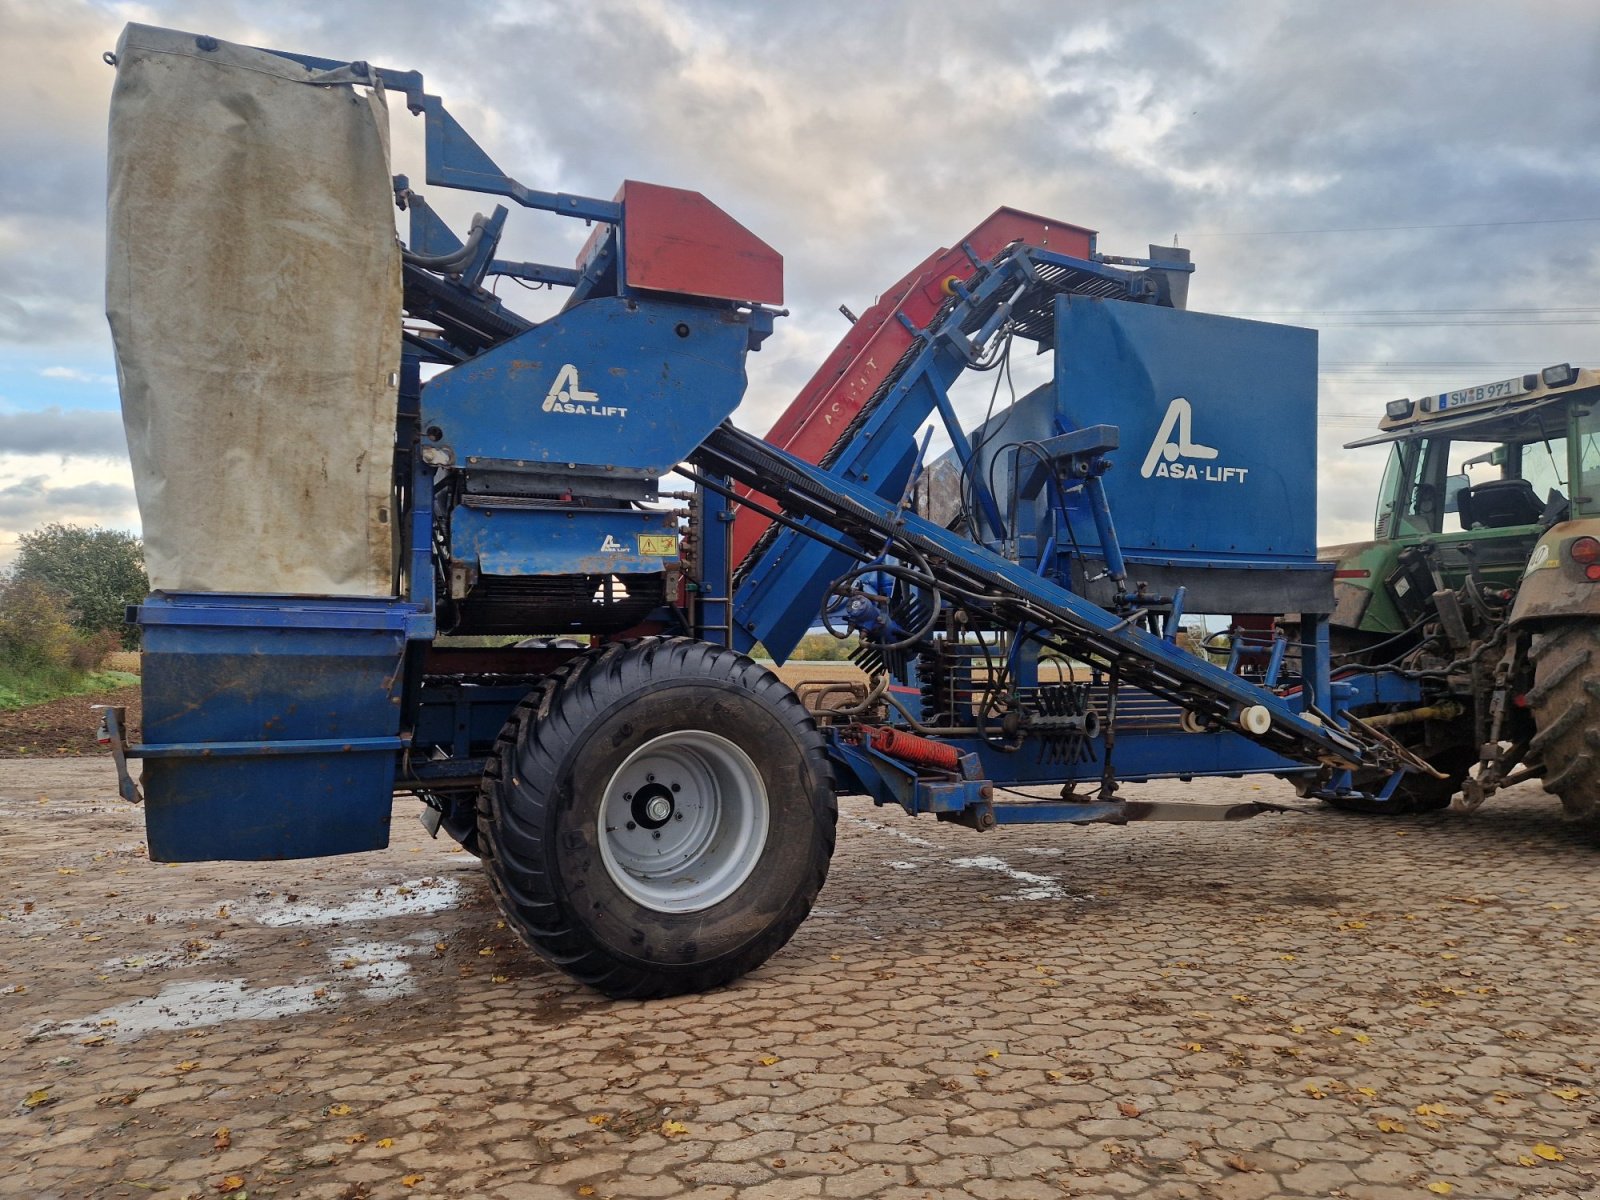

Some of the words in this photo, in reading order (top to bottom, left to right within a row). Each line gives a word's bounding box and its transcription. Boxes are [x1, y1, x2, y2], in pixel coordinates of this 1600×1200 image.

[1487, 382, 1512, 398] 971
[552, 402, 628, 417] ASA-LIFT
[1155, 462, 1249, 484] ASA-LIFT
